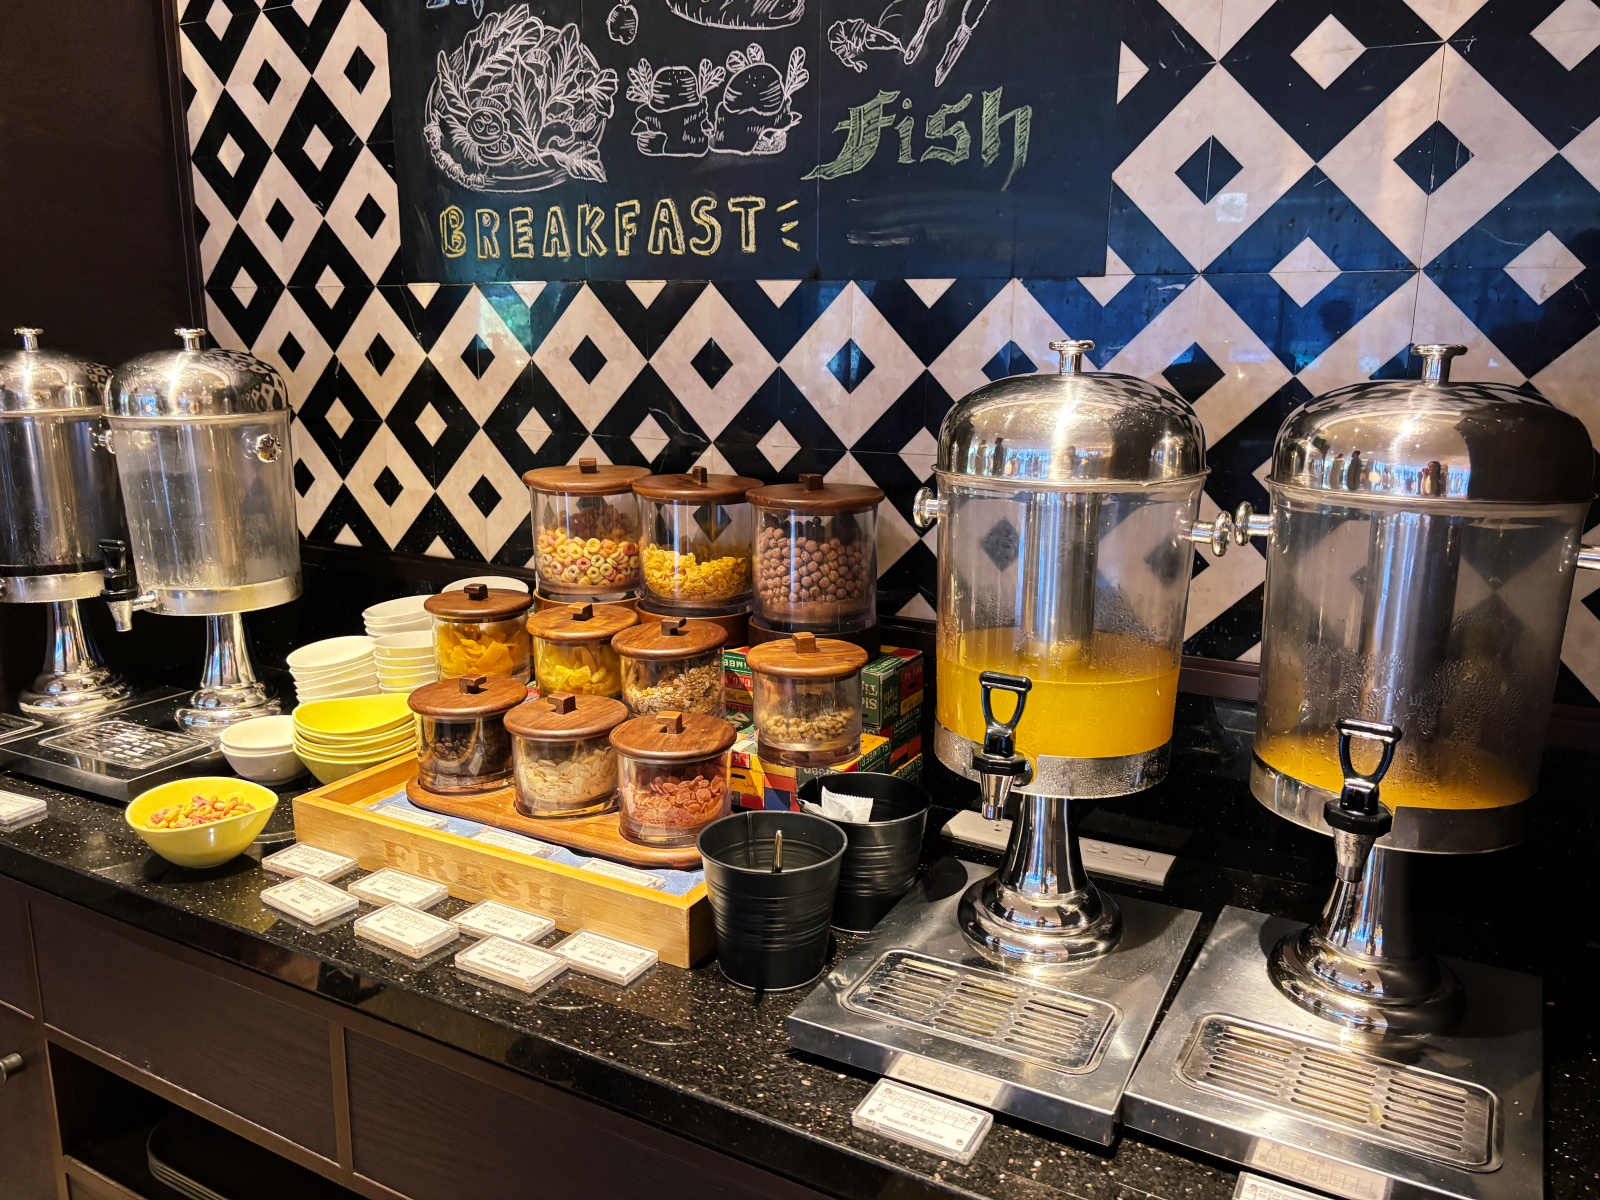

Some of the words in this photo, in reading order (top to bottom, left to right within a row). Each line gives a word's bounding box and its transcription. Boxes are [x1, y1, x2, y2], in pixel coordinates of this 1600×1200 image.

[440, 196, 766, 259] BREAKFAST
[861, 743, 889, 767] SLUMBER
[382, 839, 567, 918] FRESH
[882, 1115, 908, 1128] Passion
[909, 1122, 925, 1134] Fruit
[925, 1129, 944, 1140] Juice
